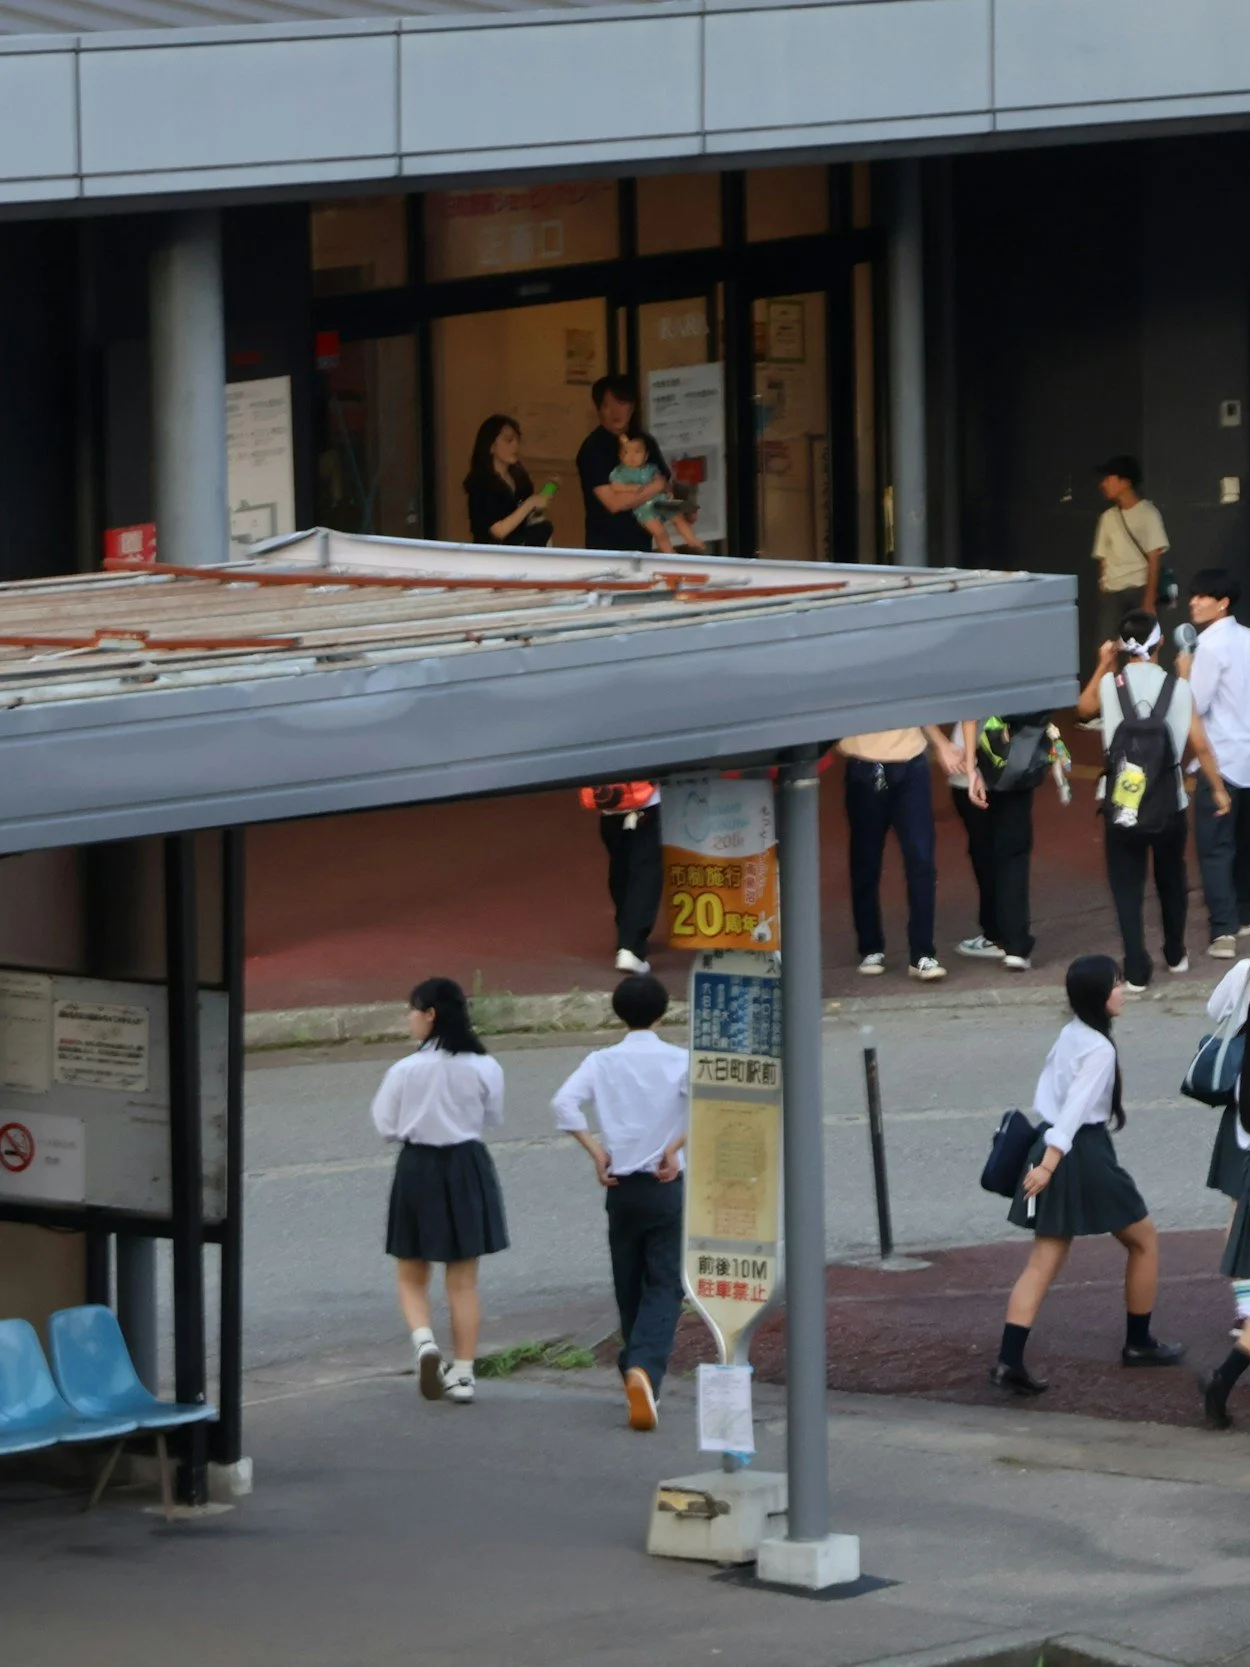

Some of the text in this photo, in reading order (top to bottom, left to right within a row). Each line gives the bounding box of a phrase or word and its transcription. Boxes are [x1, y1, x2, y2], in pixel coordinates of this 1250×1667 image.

[672, 892, 759, 938] 20周年
[698, 1057, 778, 1086] 六日町駅前
[698, 1279, 768, 1302] 駐車禁止
